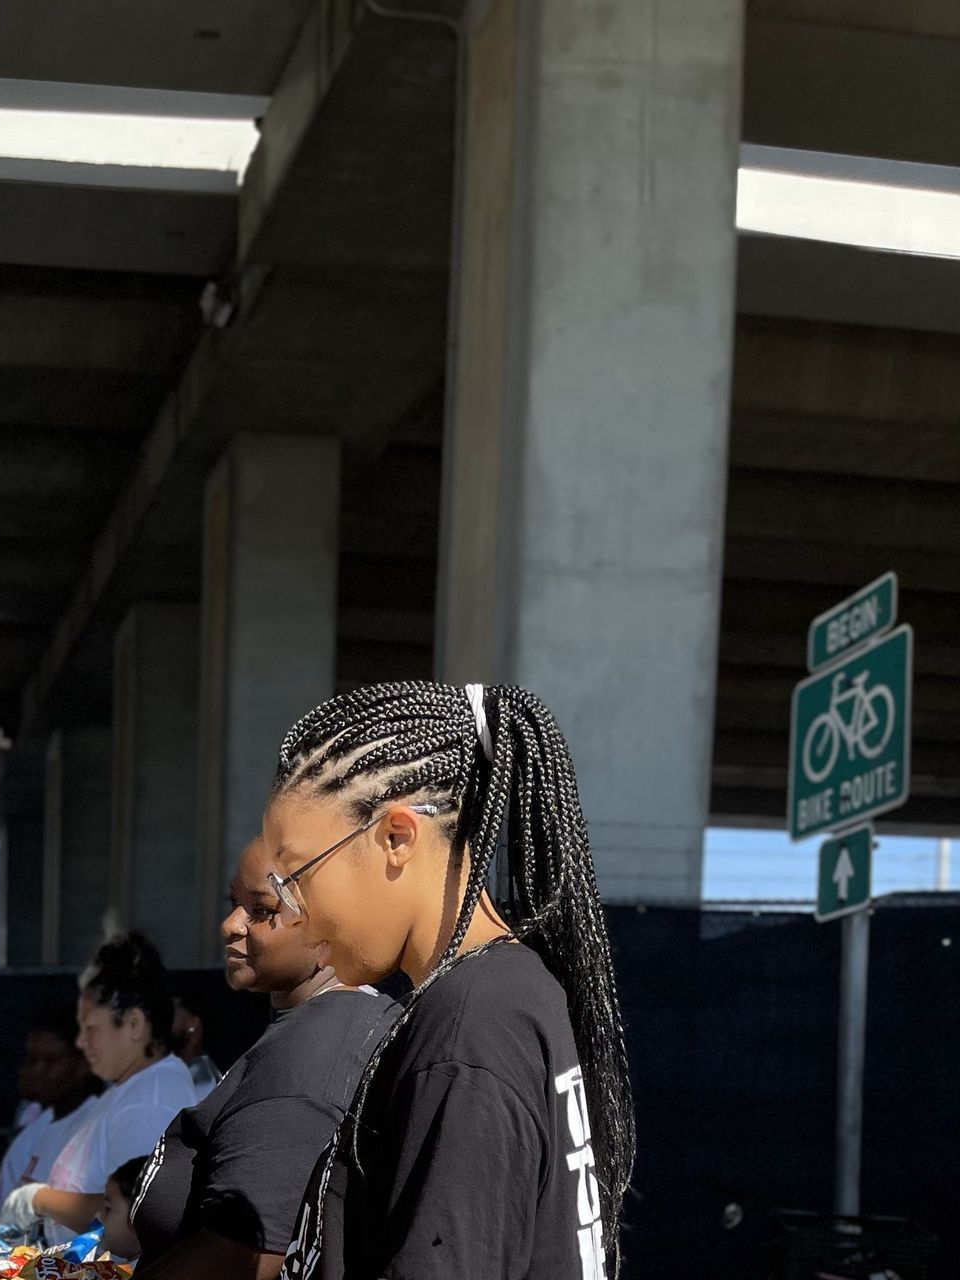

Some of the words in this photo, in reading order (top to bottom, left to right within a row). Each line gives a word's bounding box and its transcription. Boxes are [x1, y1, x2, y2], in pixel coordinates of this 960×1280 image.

[827, 594, 878, 654] BEGIN
[797, 787, 834, 831] BIKE
[839, 761, 897, 813] ROUTE
